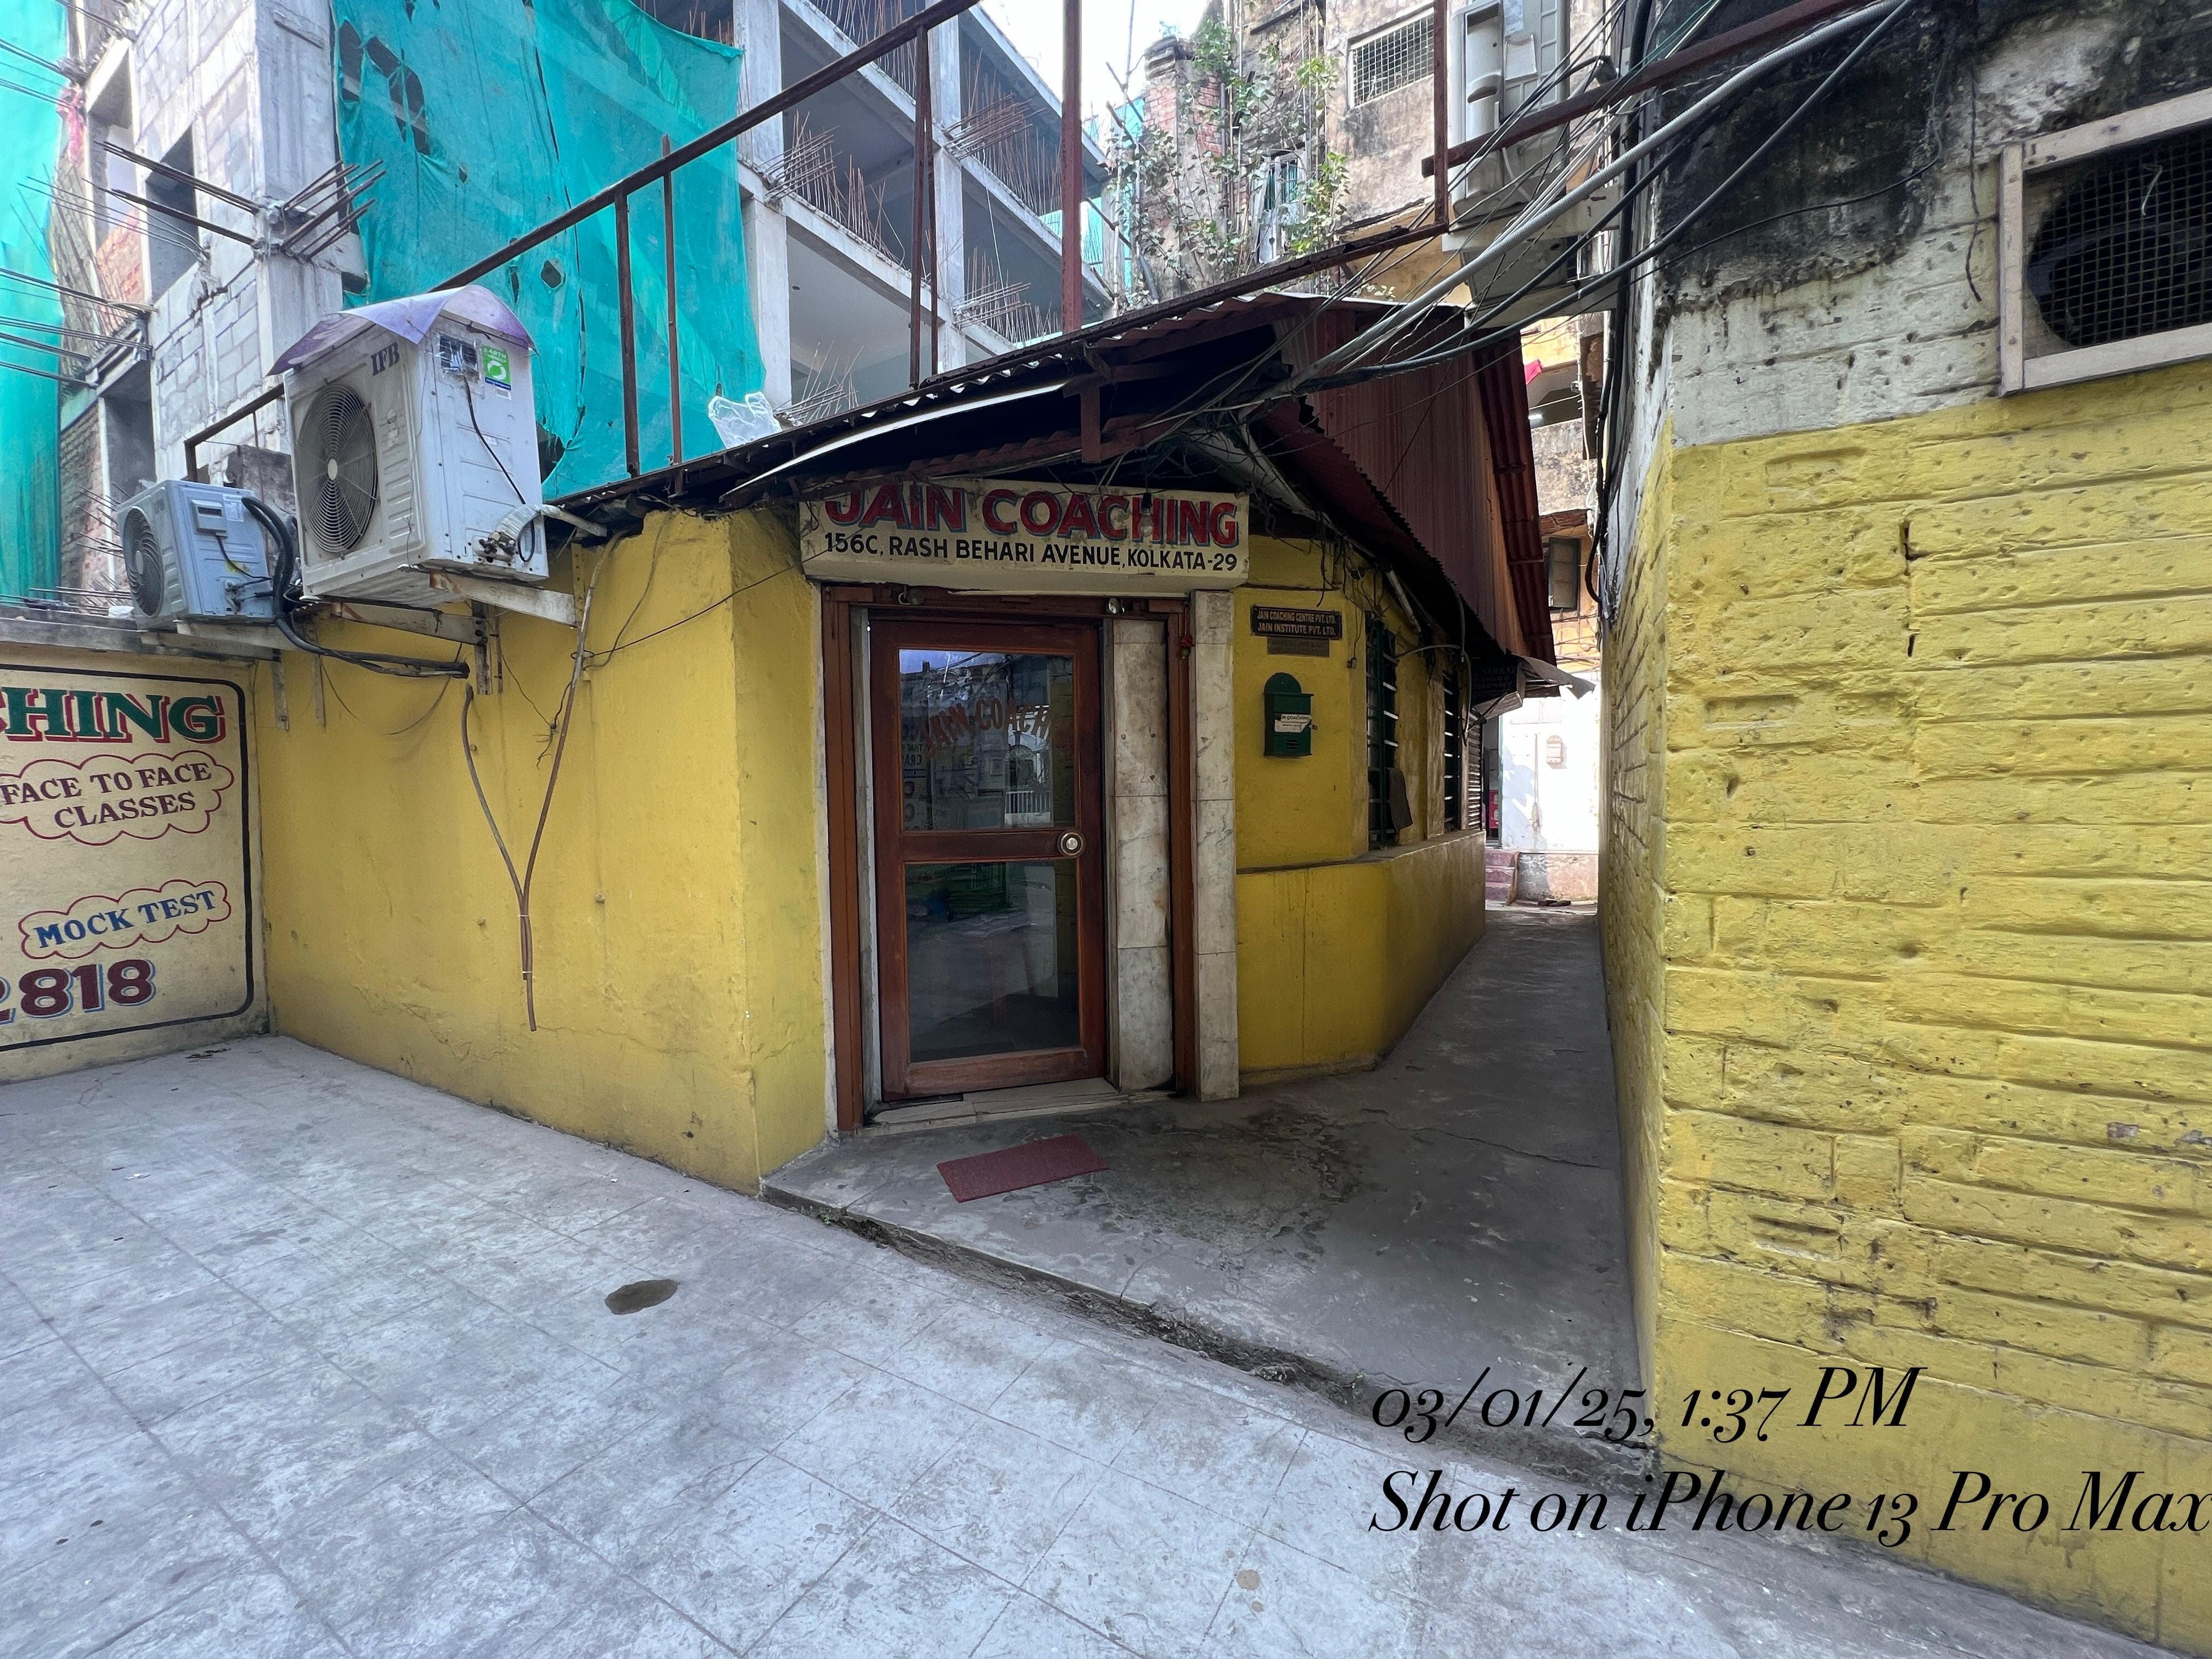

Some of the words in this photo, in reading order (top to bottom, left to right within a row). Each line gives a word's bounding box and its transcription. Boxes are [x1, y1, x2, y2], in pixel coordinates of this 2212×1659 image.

[825, 482, 967, 533] JAIN
[982, 488, 1239, 549] COACHING
[825, 532, 884, 556] 156C,
[889, 535, 948, 558] RASH
[956, 539, 1034, 562] BEHARI
[1257, 610, 1269, 620] JAIN
[1269, 611, 1295, 622] COACHING
[1295, 613, 1315, 623] CENTRE
[1257, 622, 1273, 632] JAIN
[1274, 623, 1307, 634] INSTITUTE
[0, 686, 226, 744] HING
[0, 777, 82, 805] FACE
[89, 771, 133, 794] TO
[135, 762, 212, 789] FACE
[54, 791, 196, 829] CLASSES
[33, 908, 133, 949] MOCK
[138, 890, 216, 924] TEST
